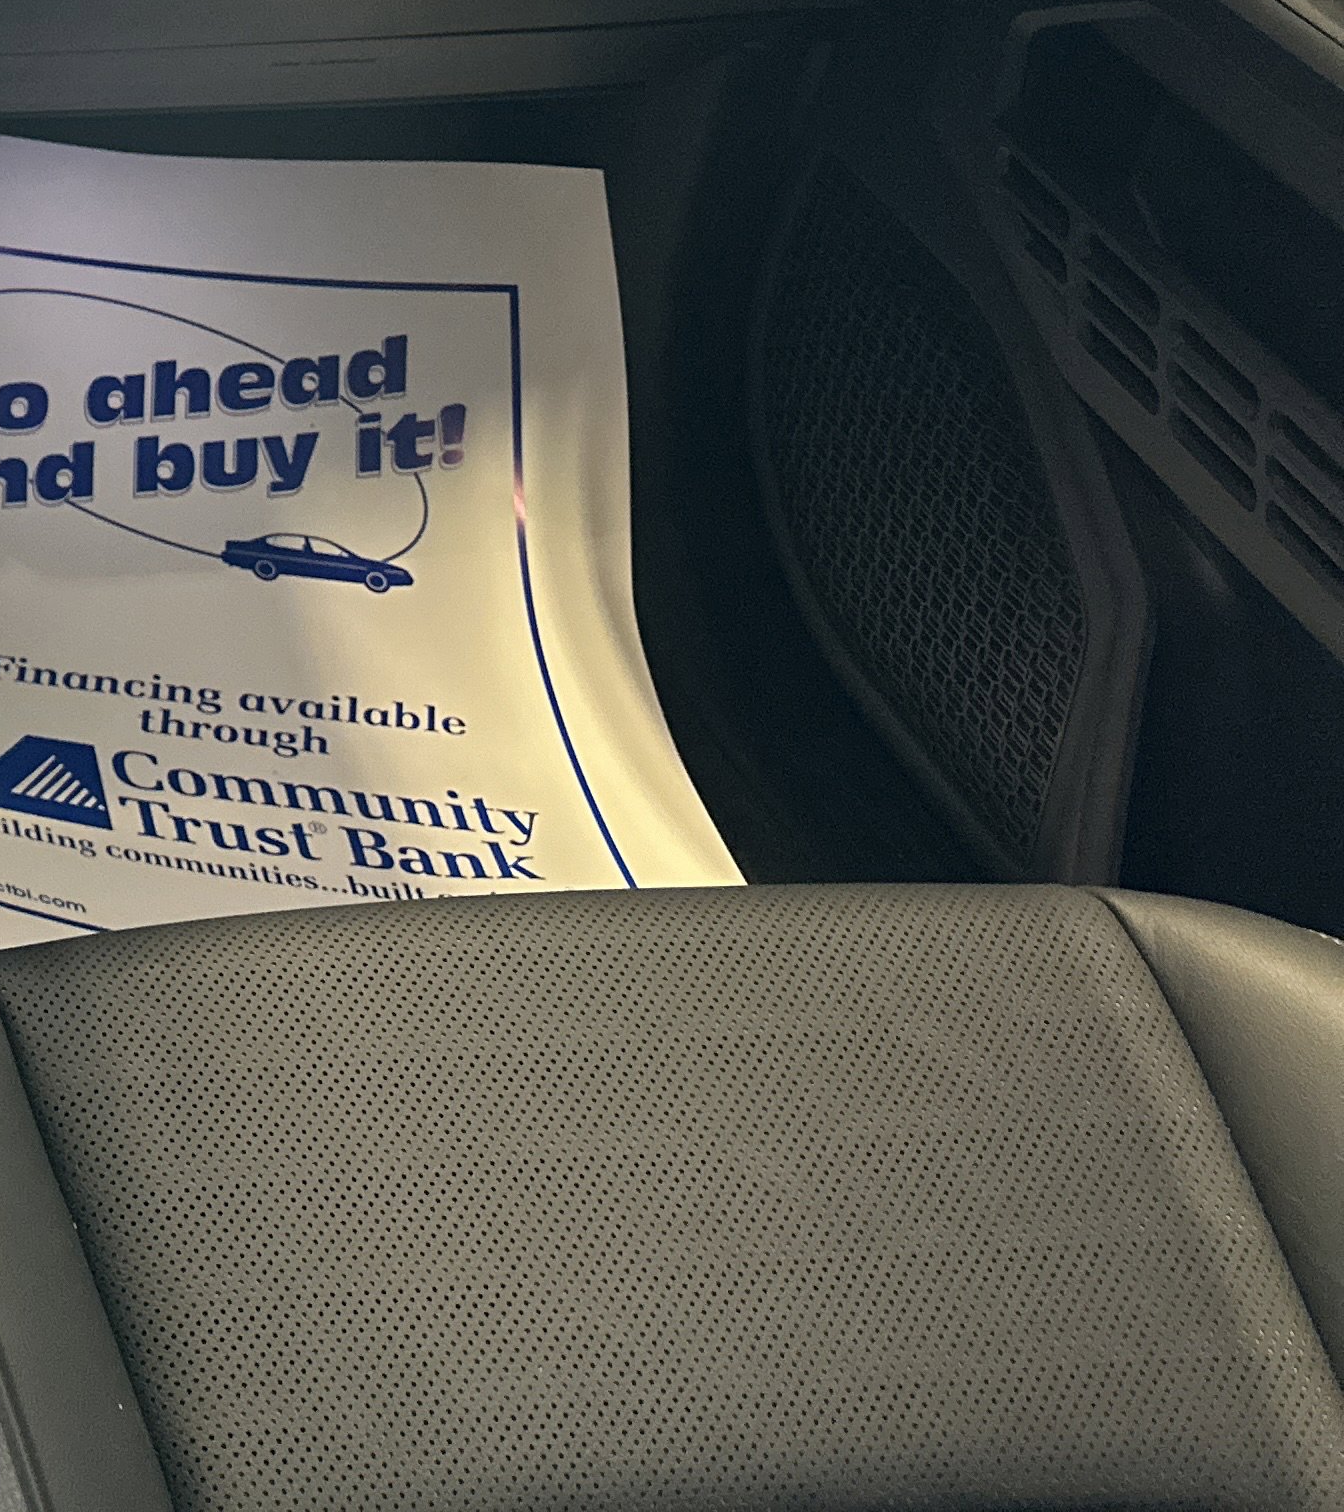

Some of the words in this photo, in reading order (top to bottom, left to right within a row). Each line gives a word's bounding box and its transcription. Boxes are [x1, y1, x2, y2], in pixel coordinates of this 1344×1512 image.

[84, 333, 409, 426] ahead
[132, 429, 320, 500] buy
[354, 402, 469, 480] it!
[138, 708, 330, 759] through
[238, 690, 468, 736] available
[111, 749, 540, 847] Community
[338, 824, 547, 881] Bank
